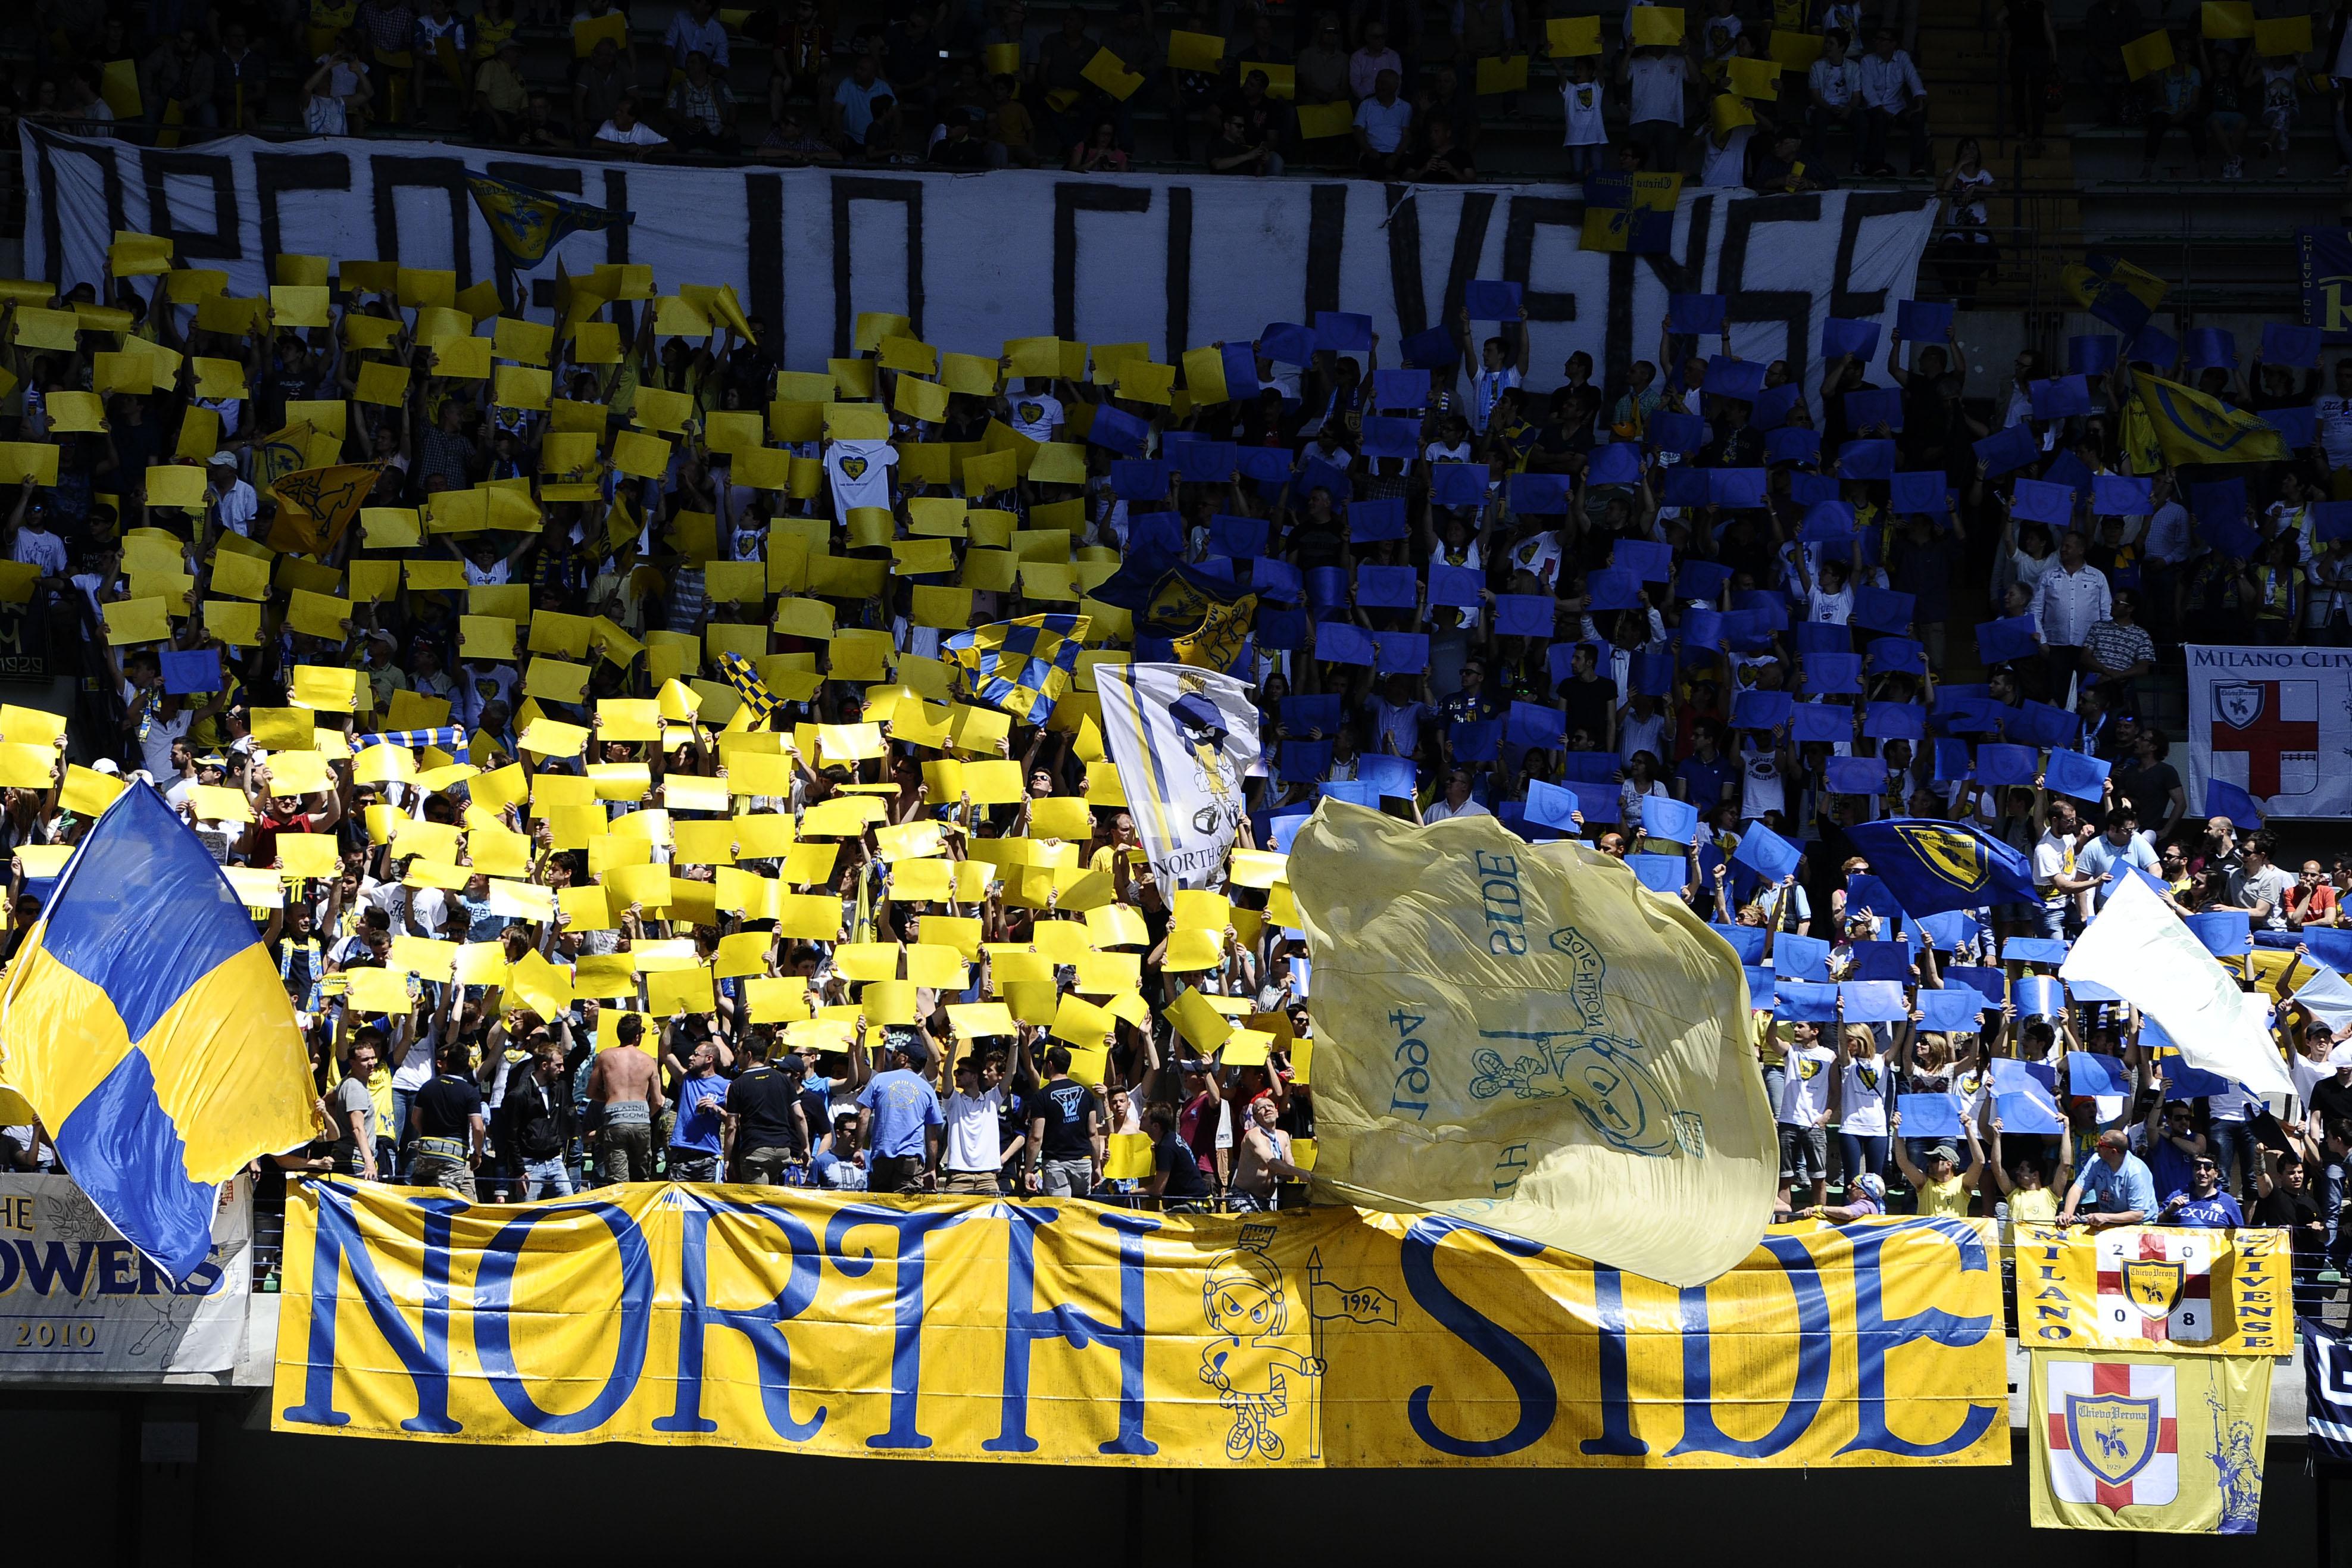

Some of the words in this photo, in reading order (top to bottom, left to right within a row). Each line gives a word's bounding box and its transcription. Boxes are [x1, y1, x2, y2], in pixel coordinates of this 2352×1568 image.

[2303, 235, 2312, 288] CHIEVO
[2194, 649, 2293, 667] MILANO
[1152, 847, 1215, 879] NORTH
[1341, 1294, 1382, 1314] 1994
[2031, 1229, 2072, 1340] MILANO
[2235, 1235, 2275, 1348] CLIVENSE
[15, 1321, 96, 1348] 2010
[283, 1176, 1159, 1455] NORTH
[1400, 1214, 1998, 1458] SIDE
